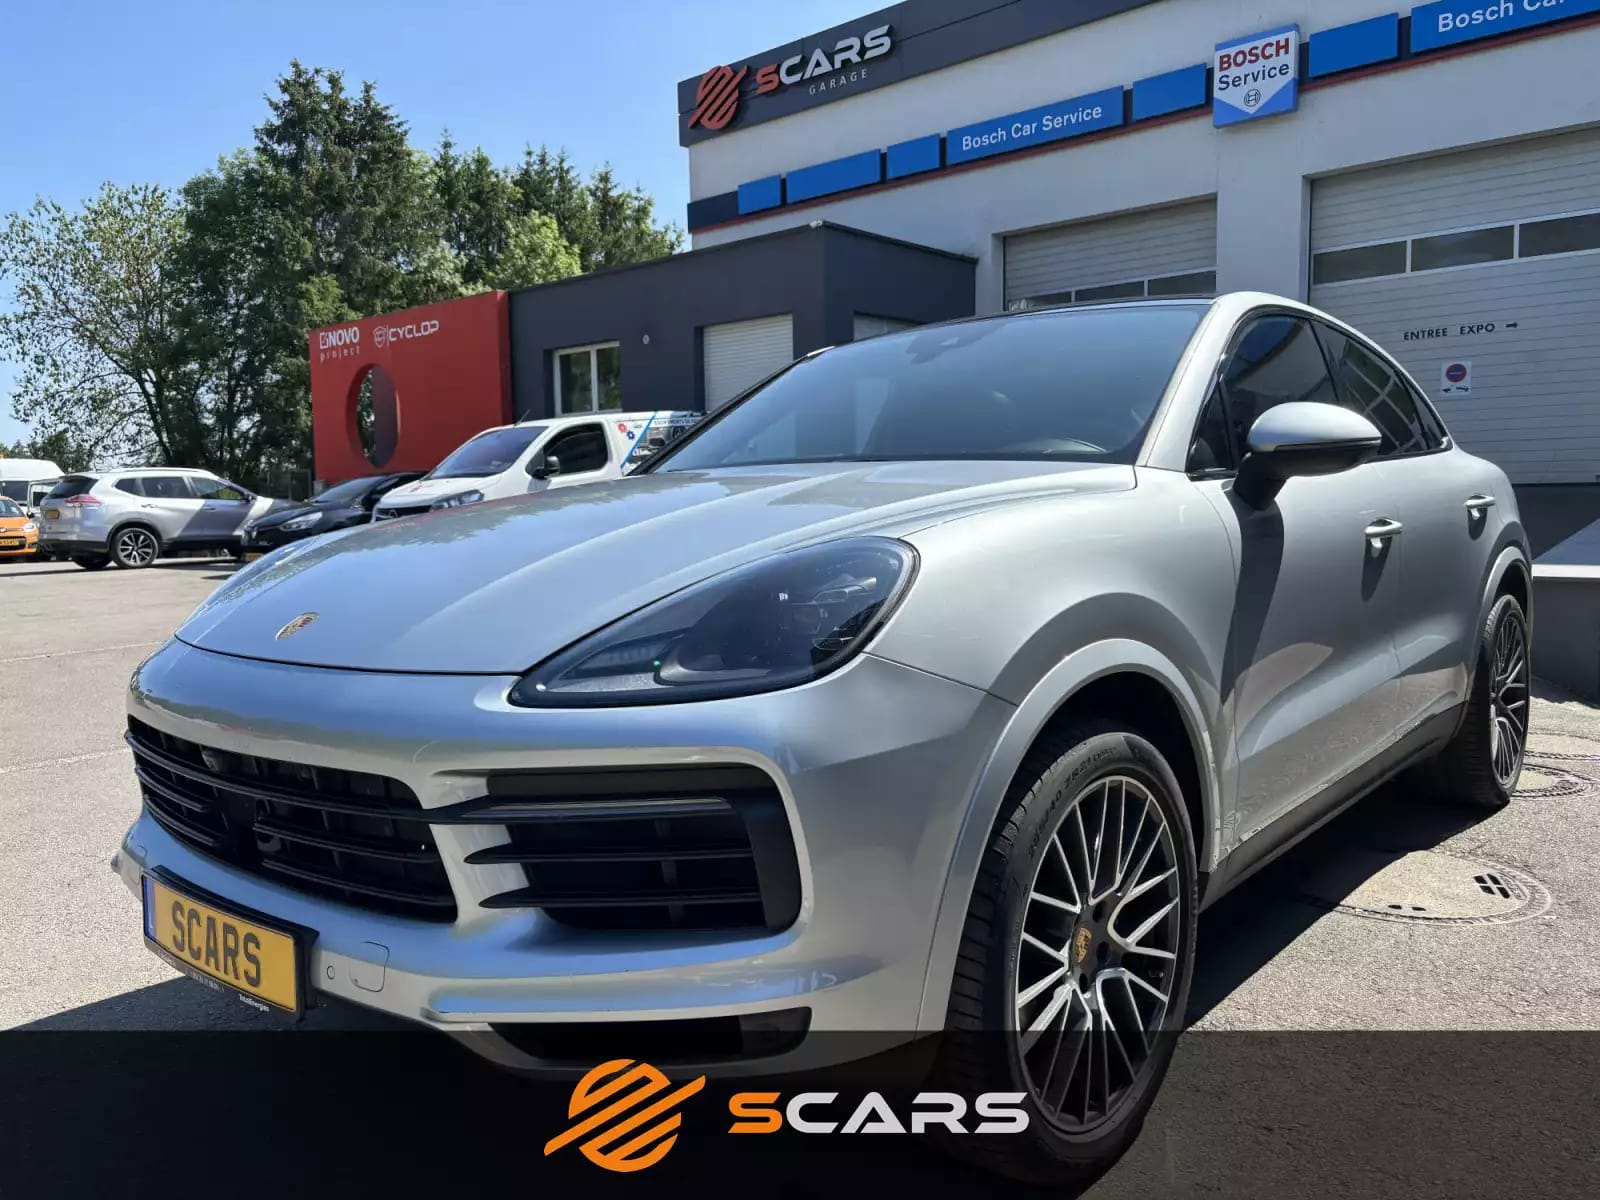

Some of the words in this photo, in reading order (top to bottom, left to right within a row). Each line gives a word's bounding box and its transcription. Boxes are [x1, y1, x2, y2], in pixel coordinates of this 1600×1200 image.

[1438, 1, 1514, 32] Bosch
[756, 24, 892, 95] SCARS
[1219, 37, 1290, 72] BOSCH
[809, 68, 868, 95] GARAGE
[1218, 63, 1290, 91] Service
[962, 127, 1007, 151] Bosch
[1011, 122, 1037, 139] Car
[1042, 106, 1103, 131] Service
[389, 320, 440, 341] CYCLOP
[1403, 327, 1449, 341] ENTREE
[1460, 323, 1496, 335] EXPO
[172, 900, 261, 988] SCARS
